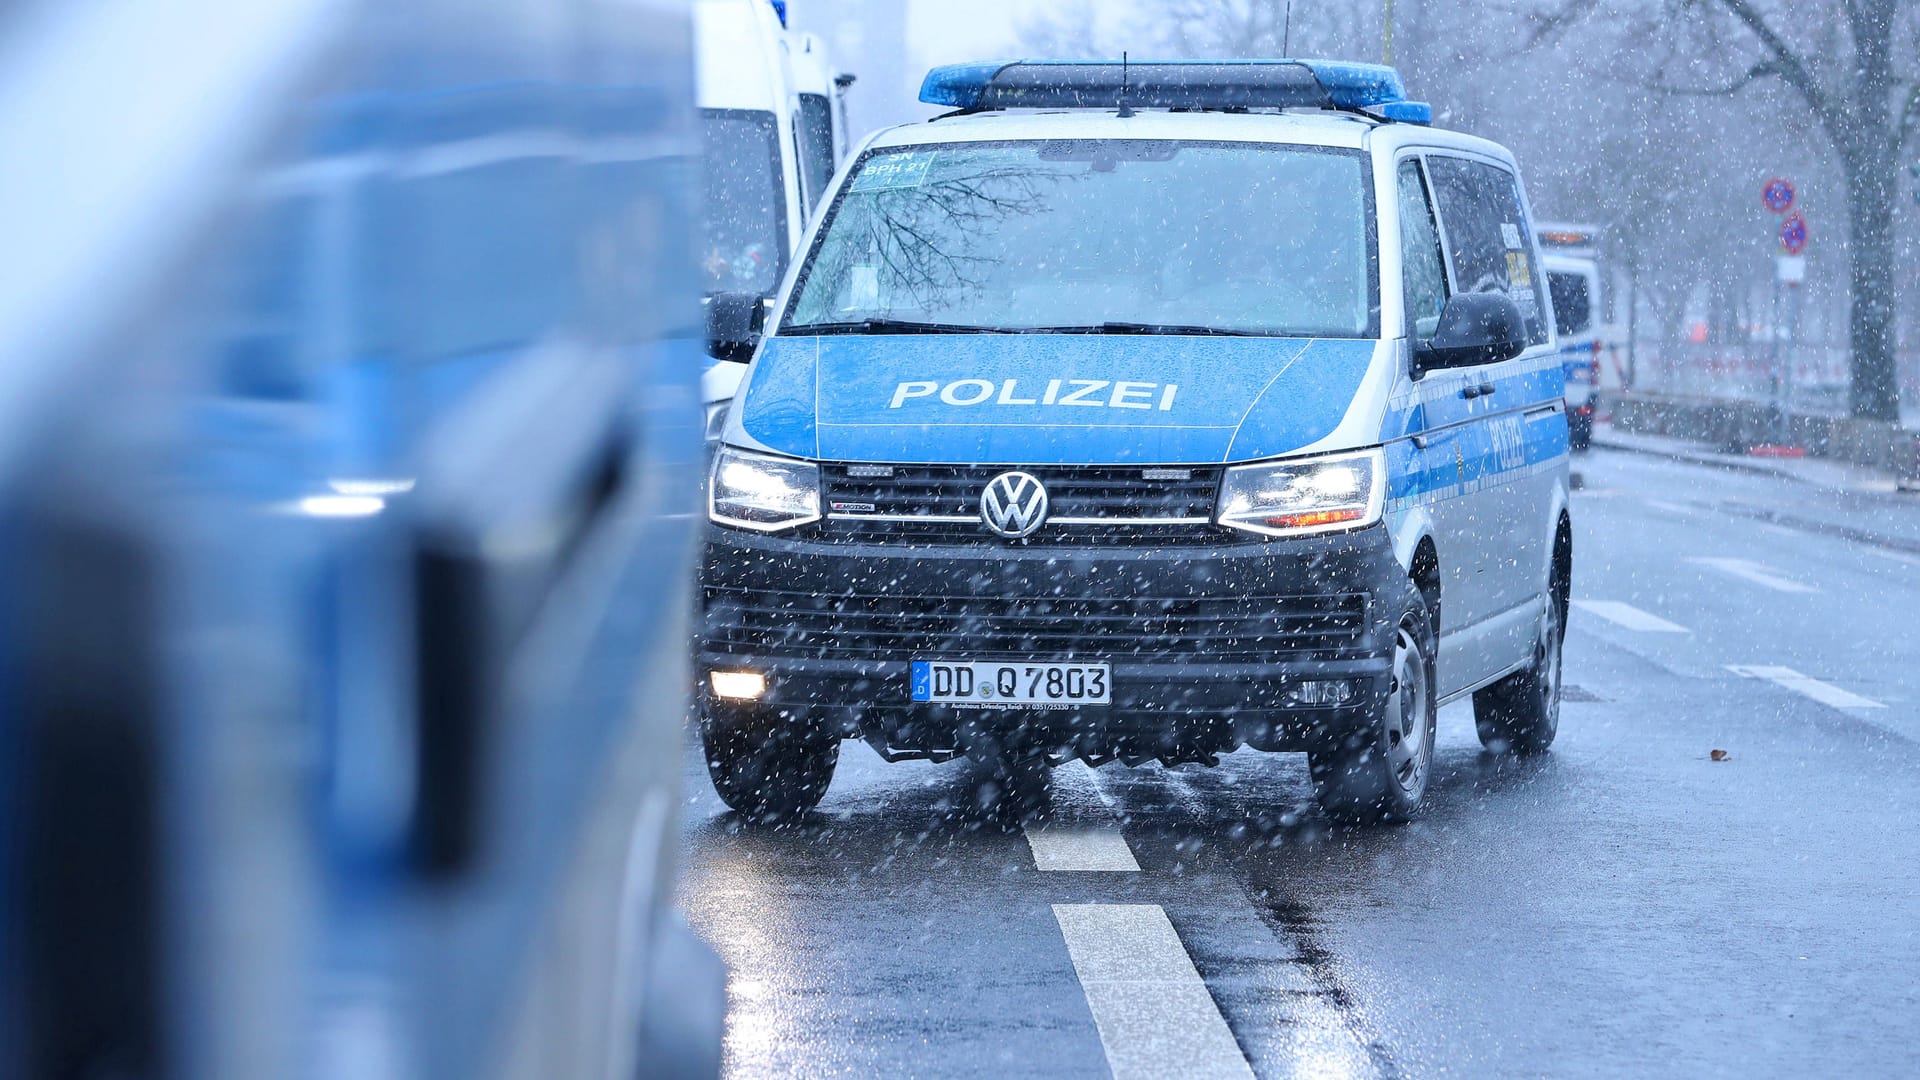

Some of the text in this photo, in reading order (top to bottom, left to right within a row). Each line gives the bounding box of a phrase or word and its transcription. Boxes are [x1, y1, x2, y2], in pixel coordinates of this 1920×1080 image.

[864, 163, 902, 176] BPH
[889, 378, 1178, 411] POLIZEI
[1487, 416, 1525, 471] POLIZEI
[984, 473, 1045, 535] VW
[917, 685, 925, 695] D
[933, 666, 1106, 698] DD Q 7803
[951, 703, 980, 711] Autohaus
